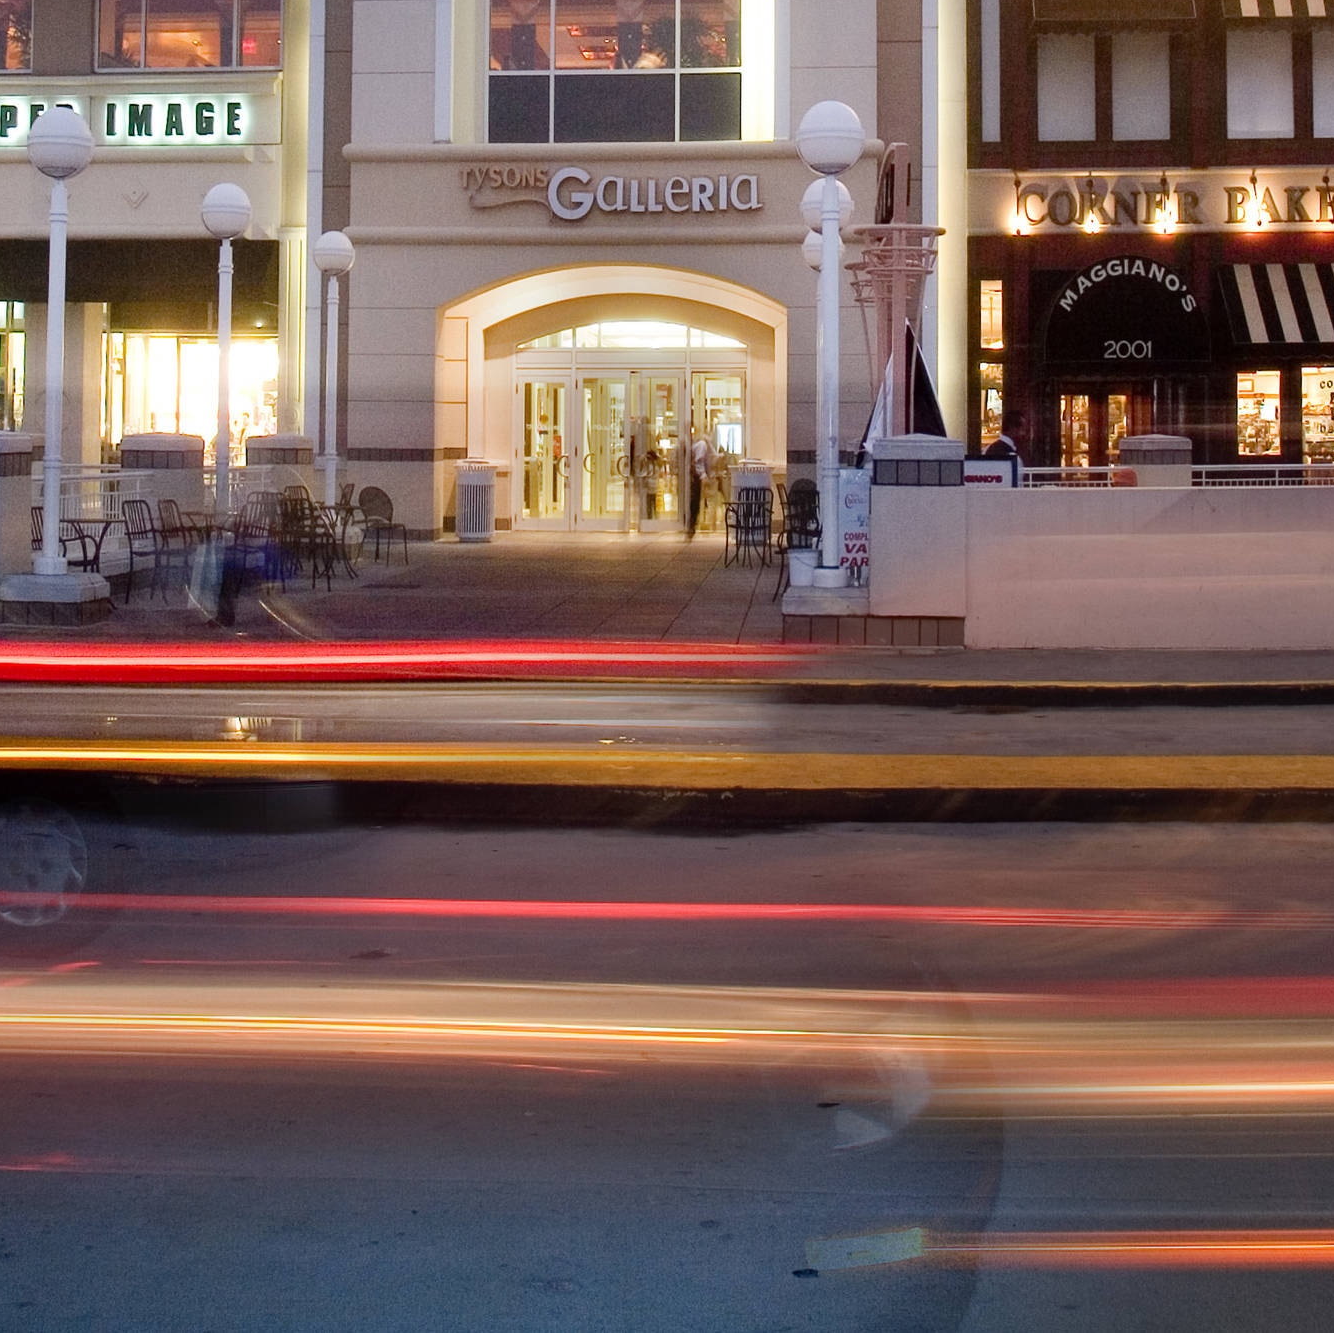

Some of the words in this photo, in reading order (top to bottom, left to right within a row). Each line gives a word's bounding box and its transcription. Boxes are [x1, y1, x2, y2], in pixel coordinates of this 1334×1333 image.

[106, 102, 242, 136] IMAGE
[1020, 189, 1204, 226] CORNER
[1059, 259, 1197, 313] MAGGIANO'S
[1103, 339, 1153, 359] 2001
